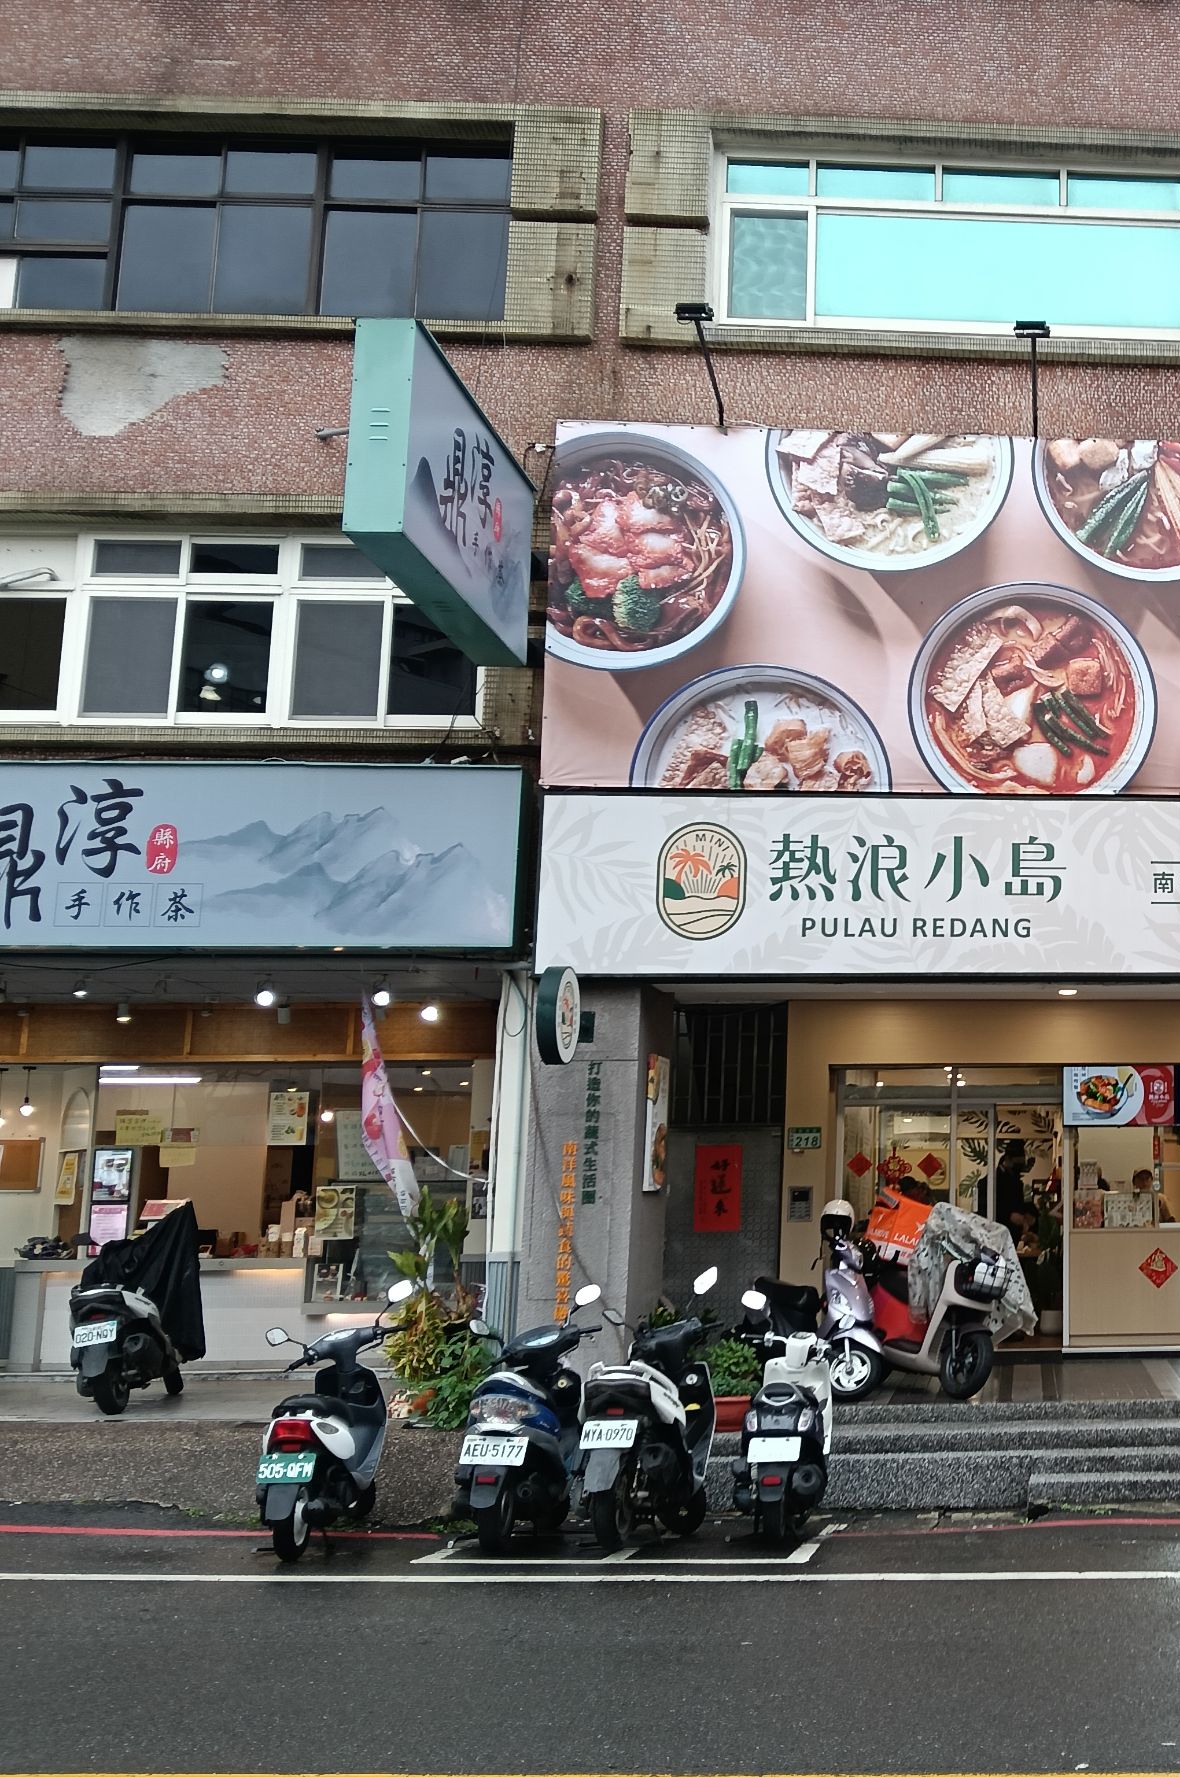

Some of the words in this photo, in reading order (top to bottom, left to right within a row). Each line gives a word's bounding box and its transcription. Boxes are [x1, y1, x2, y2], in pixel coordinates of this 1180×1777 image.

[149, 828, 174, 872] 縣府
[695, 832, 731, 852] MINI
[768, 833, 1067, 904] 熱浪小島
[65, 888, 195, 922] 手作茶
[801, 917, 898, 938] PULAU
[912, 917, 1032, 938] REDANG
[794, 1135, 819, 1147] 218
[463, 1443, 524, 1459] AEU-5177
[258, 1461, 313, 1479] 505-QFM
